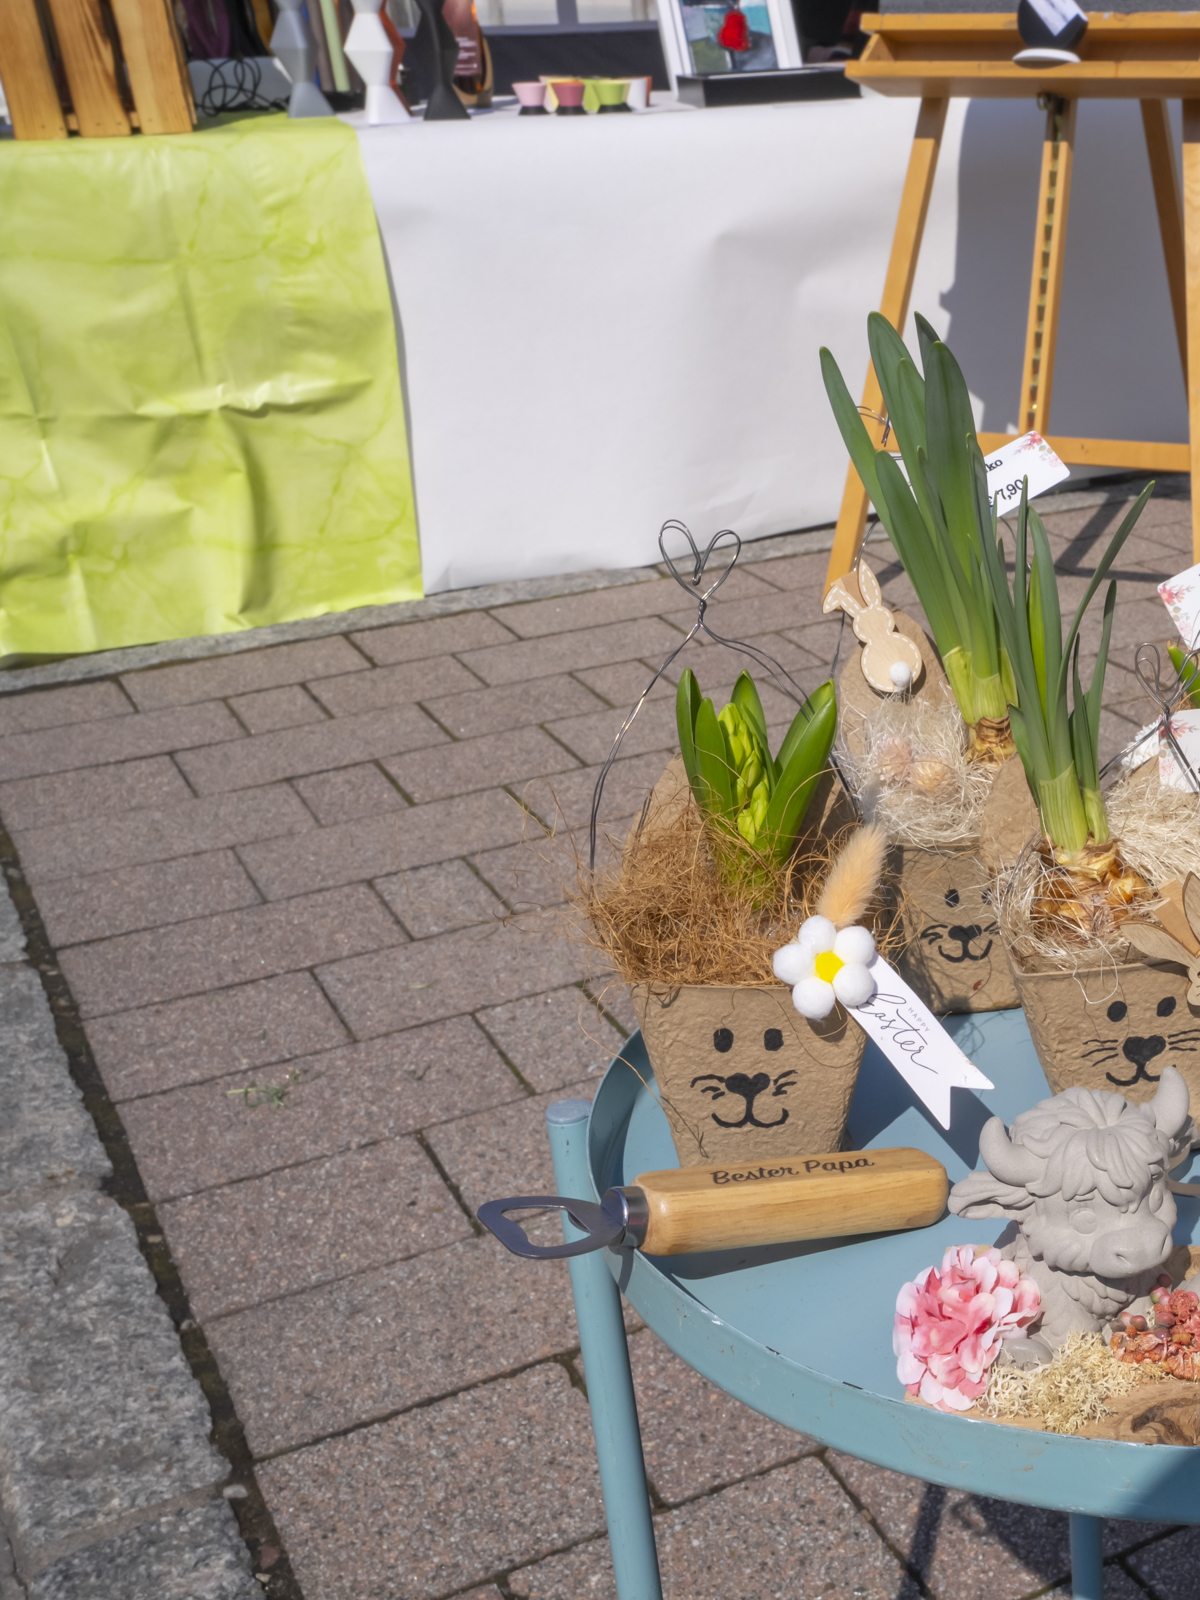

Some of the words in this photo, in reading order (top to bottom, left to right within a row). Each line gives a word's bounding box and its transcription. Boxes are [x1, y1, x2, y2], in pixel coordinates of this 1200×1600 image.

[906, 1007, 931, 1033] HAPPY
[856, 993, 939, 1075] Easter
[710, 1167, 800, 1185] Bester
[802, 1158, 875, 1174] Papa
